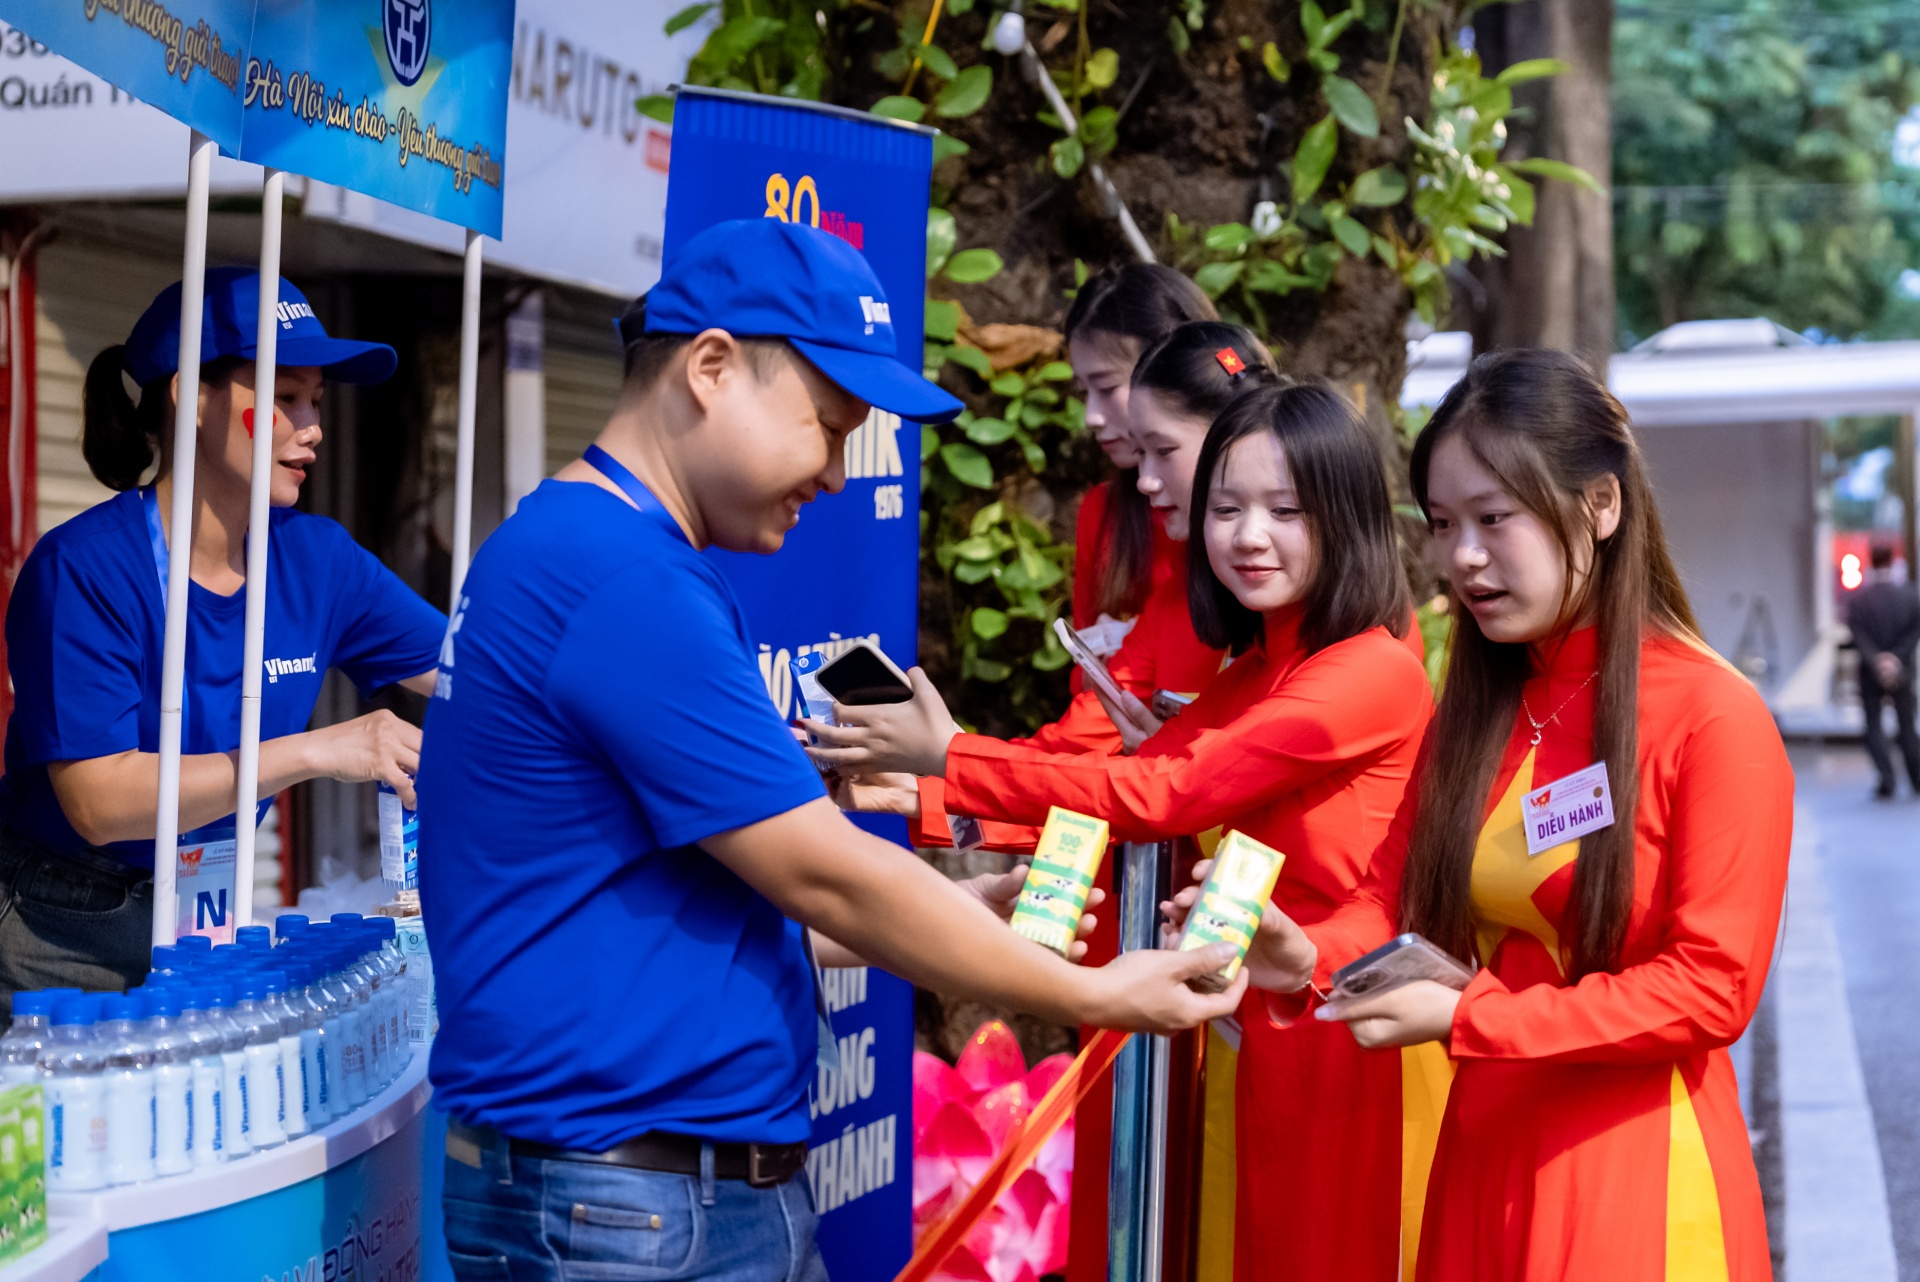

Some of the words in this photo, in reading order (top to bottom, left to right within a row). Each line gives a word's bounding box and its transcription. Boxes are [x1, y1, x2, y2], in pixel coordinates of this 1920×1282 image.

[0, 72, 93, 111] Quán
[243, 57, 285, 108] Hà
[287, 71, 325, 127] Nội
[326, 88, 352, 130] xin
[354, 95, 387, 142] chào
[397, 106, 424, 168] Yêu
[764, 173, 820, 228] 80
[1569, 800, 1604, 827] HÀNH
[196, 888, 227, 930] N
